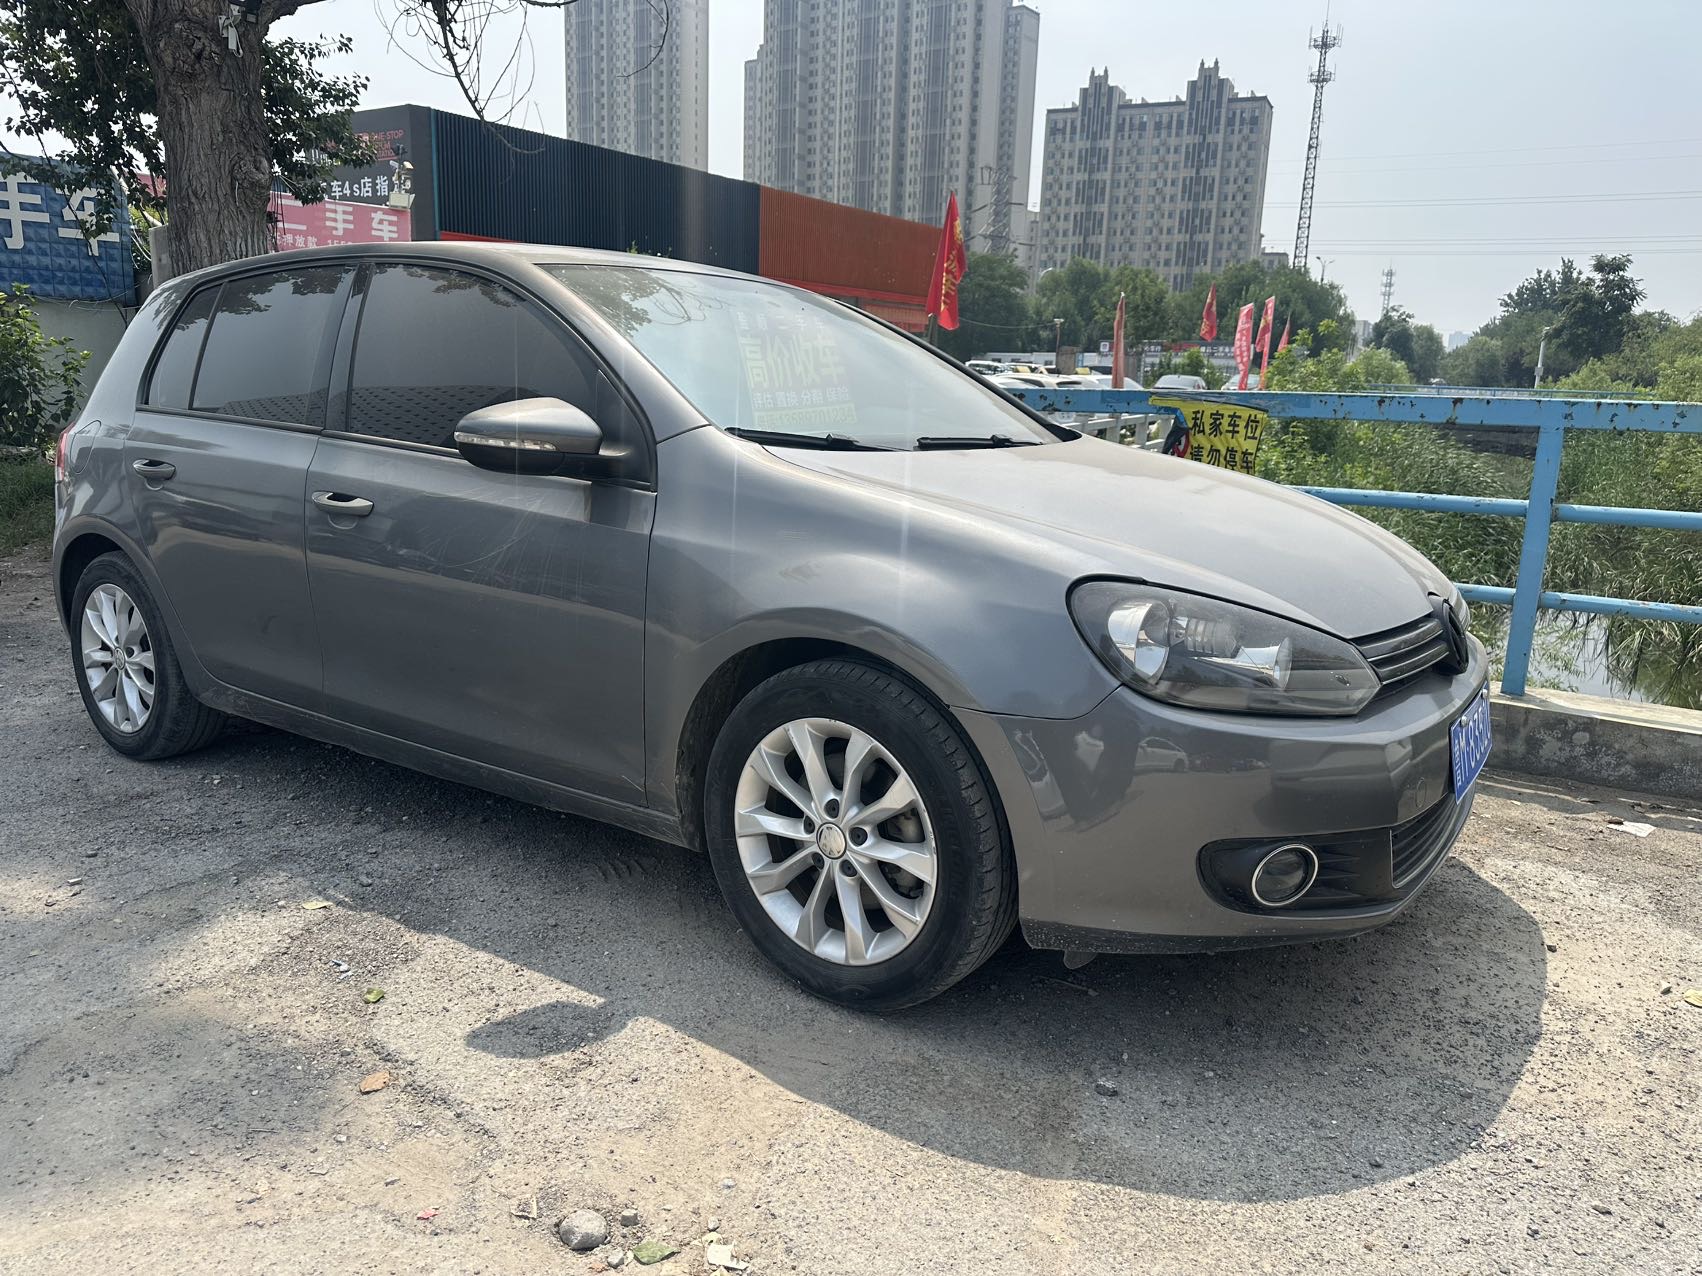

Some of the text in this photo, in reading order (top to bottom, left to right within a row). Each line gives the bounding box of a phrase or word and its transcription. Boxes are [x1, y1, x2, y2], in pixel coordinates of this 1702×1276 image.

[271, 197, 398, 241] 二手车
[740, 332, 846, 388] 高价收车
[1190, 409, 1260, 441] 私家车位
[1189, 444, 1254, 474] 请勿停车
